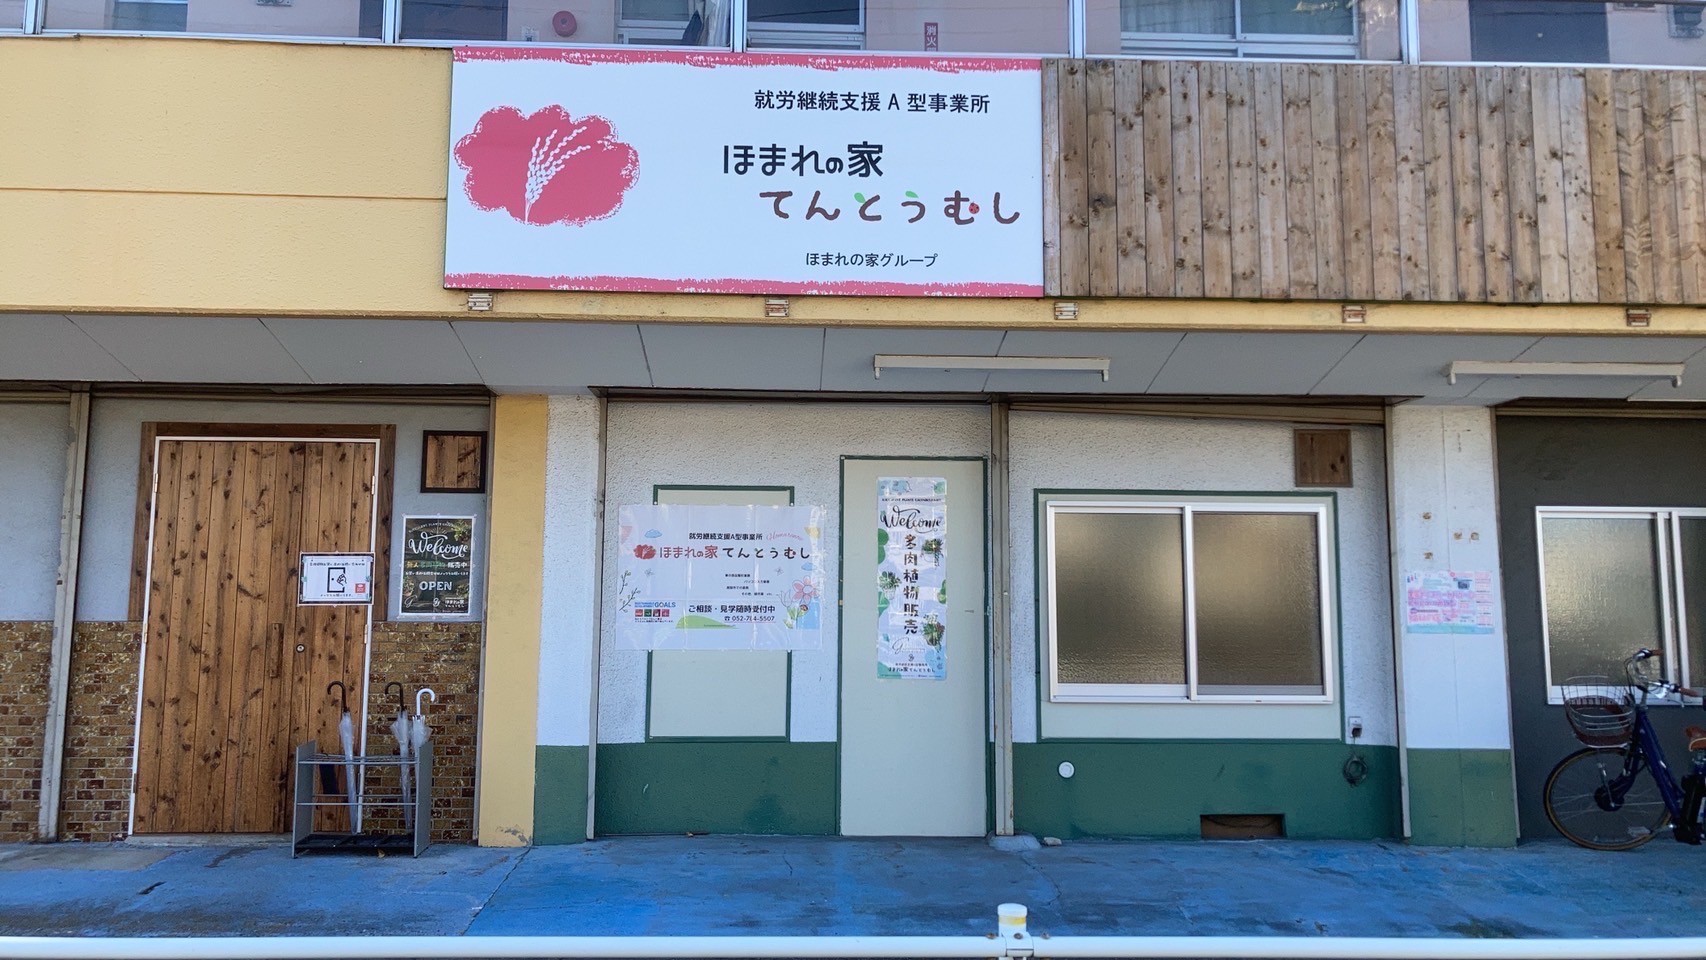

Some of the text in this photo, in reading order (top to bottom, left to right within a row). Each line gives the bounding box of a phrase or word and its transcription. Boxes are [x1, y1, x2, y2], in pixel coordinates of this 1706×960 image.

[926, 25, 937, 51] 消火
[723, 141, 883, 177] ほまれの家
[759, 190, 1020, 225] てんとうむし
[805, 252, 938, 268] ほまれの家グループ
[880, 505, 942, 533] Welcome
[409, 531, 469, 560] Welcome
[419, 581, 453, 591] OPEN
[903, 534, 919, 634] 多肉植物販売
